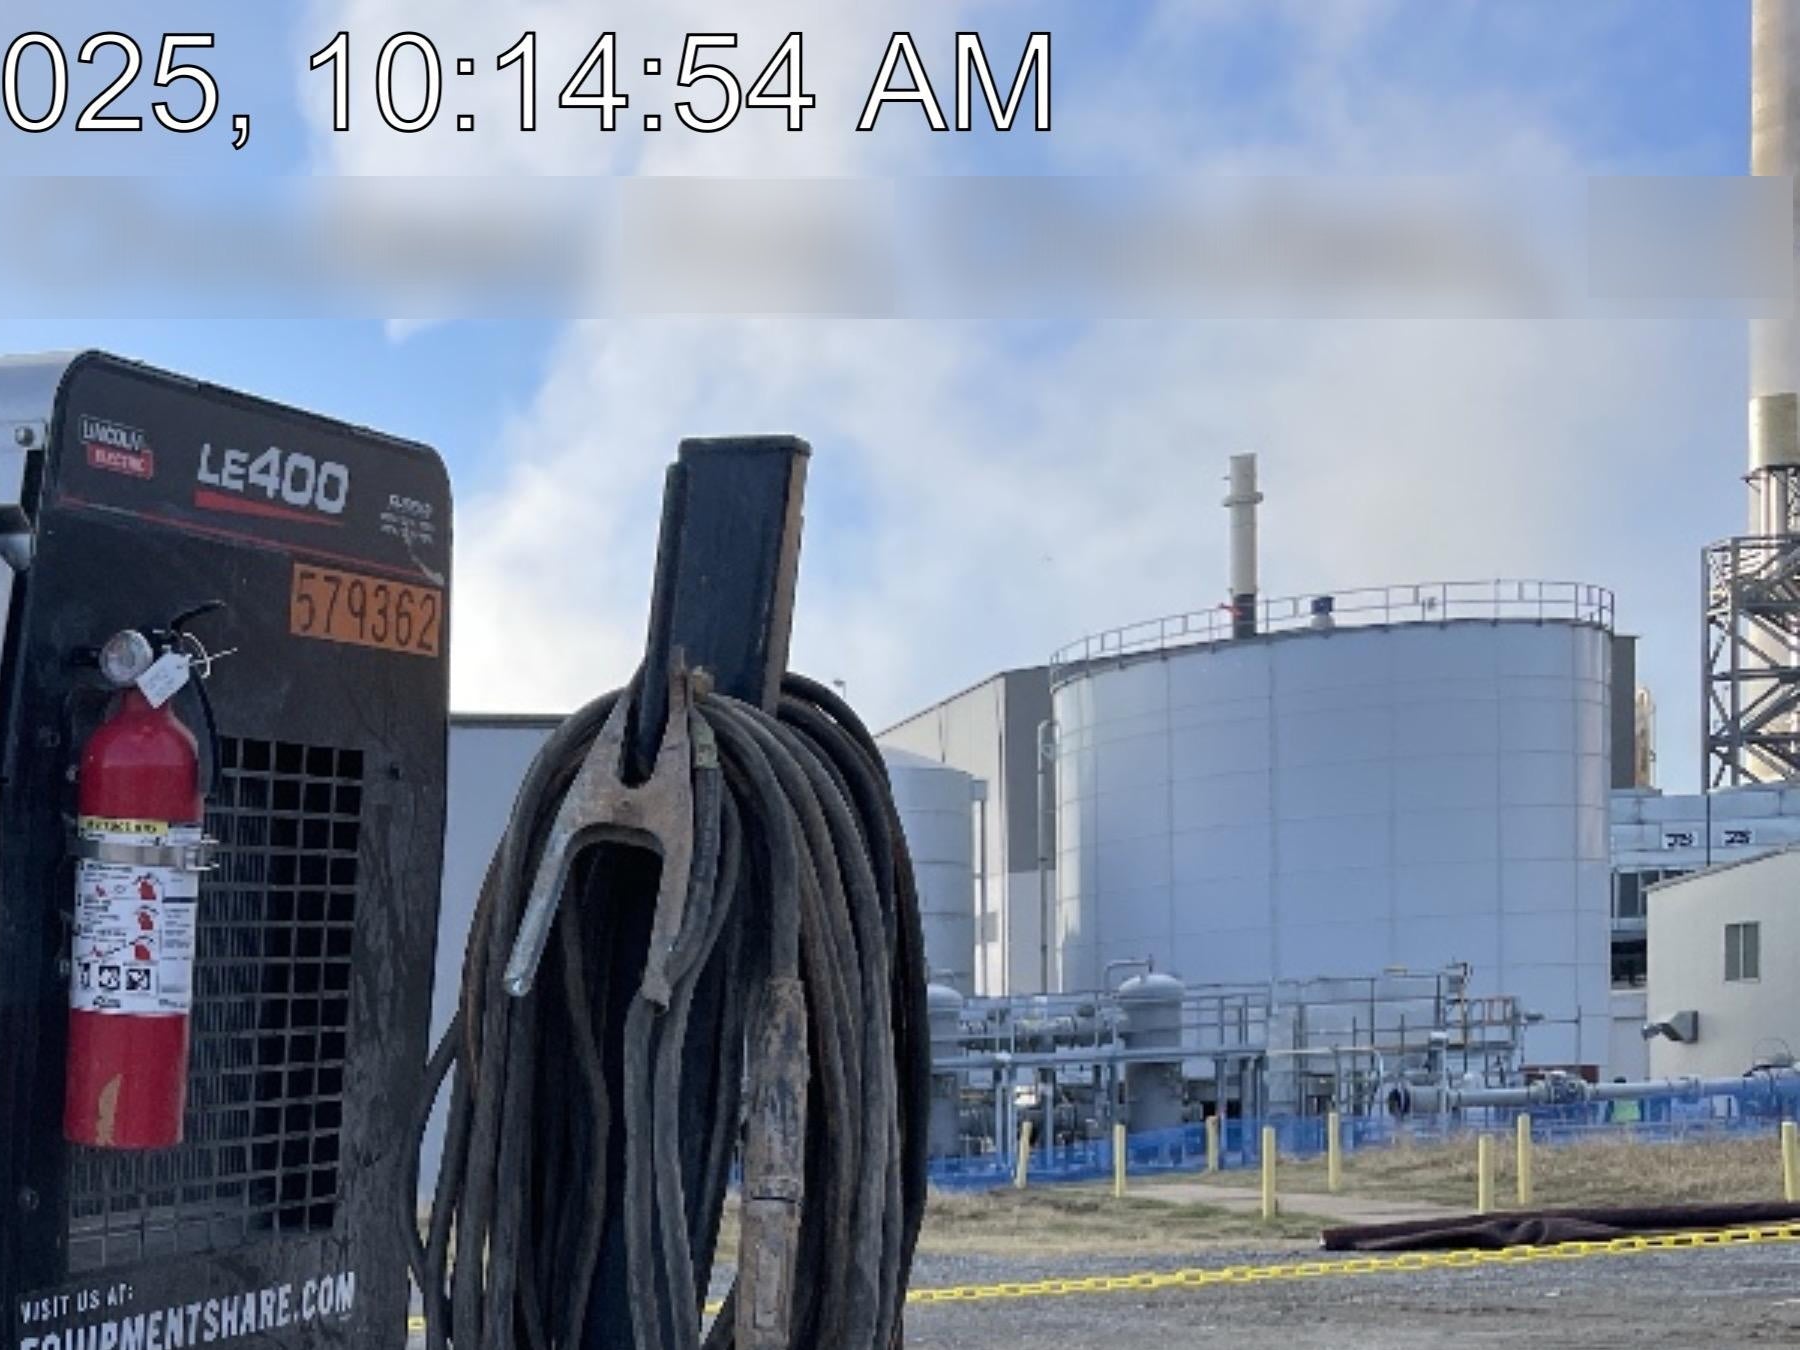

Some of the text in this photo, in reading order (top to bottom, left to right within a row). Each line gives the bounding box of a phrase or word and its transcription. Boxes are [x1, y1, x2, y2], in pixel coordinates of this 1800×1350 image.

[197, 443, 349, 514] LE400
[296, 569, 437, 652] 579362
[20, 1283, 134, 1324] VISIT US AT:
